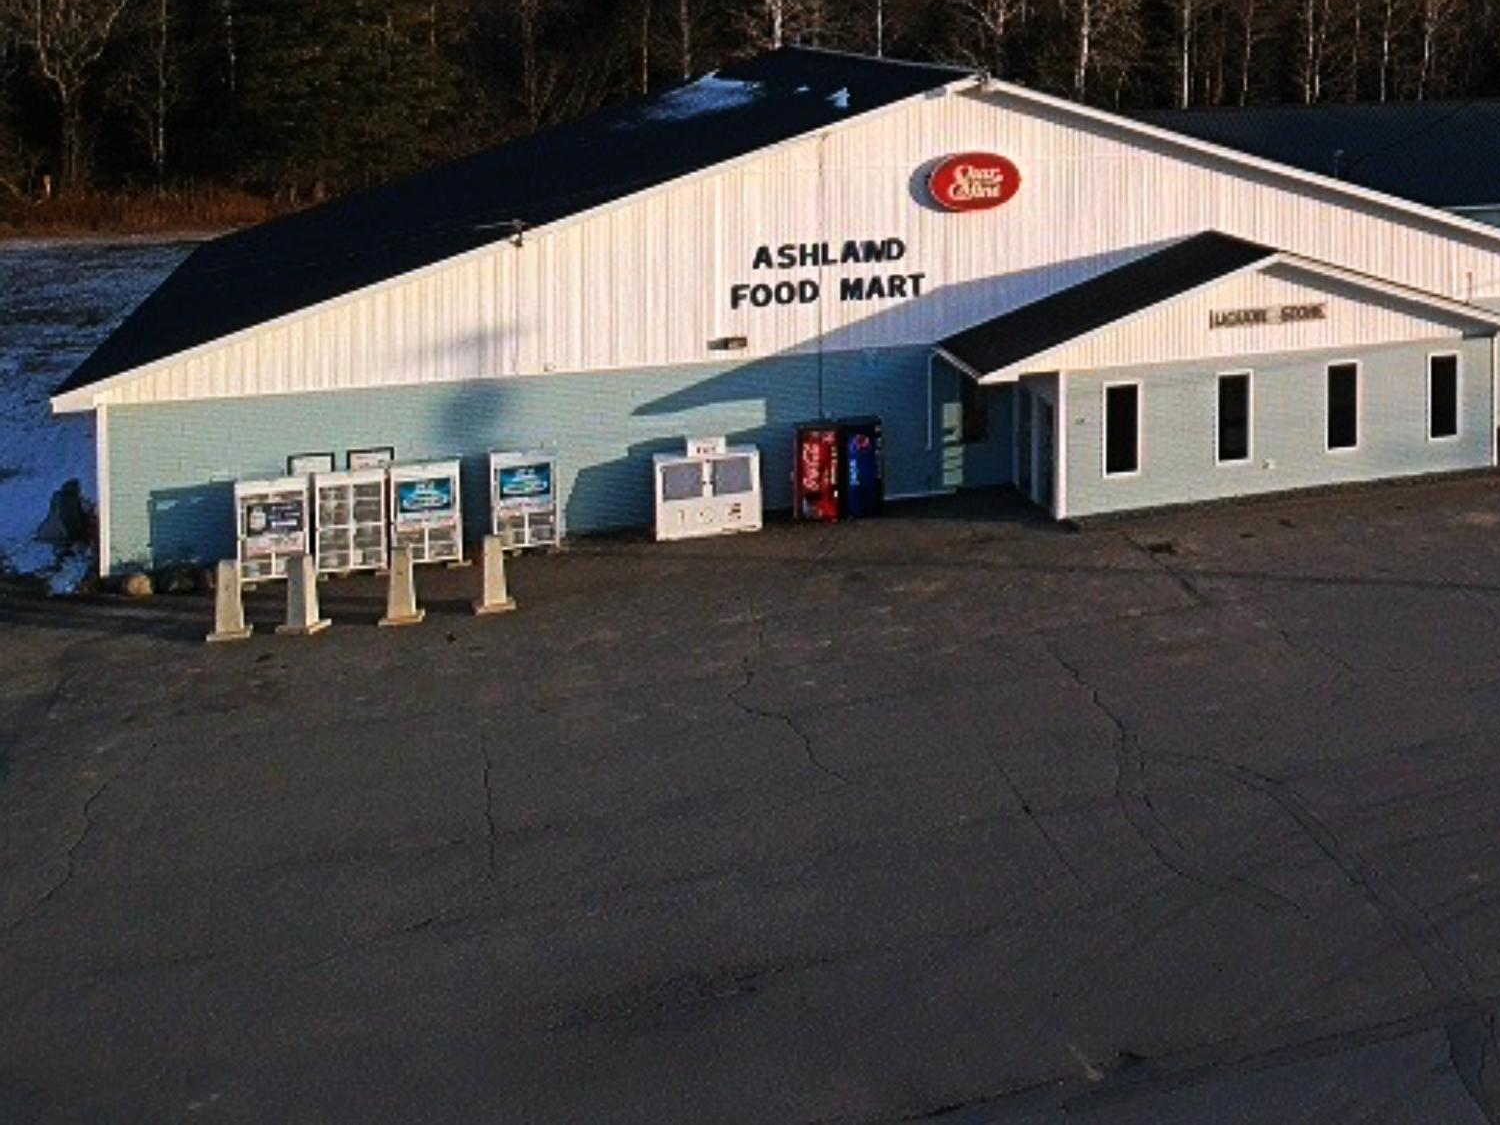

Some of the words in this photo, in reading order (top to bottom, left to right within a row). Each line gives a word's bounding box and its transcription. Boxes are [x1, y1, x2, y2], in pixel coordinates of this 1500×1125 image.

[752, 238, 906, 269] ASHLAND
[730, 280, 820, 309] FOOD
[839, 274, 926, 301] MART
